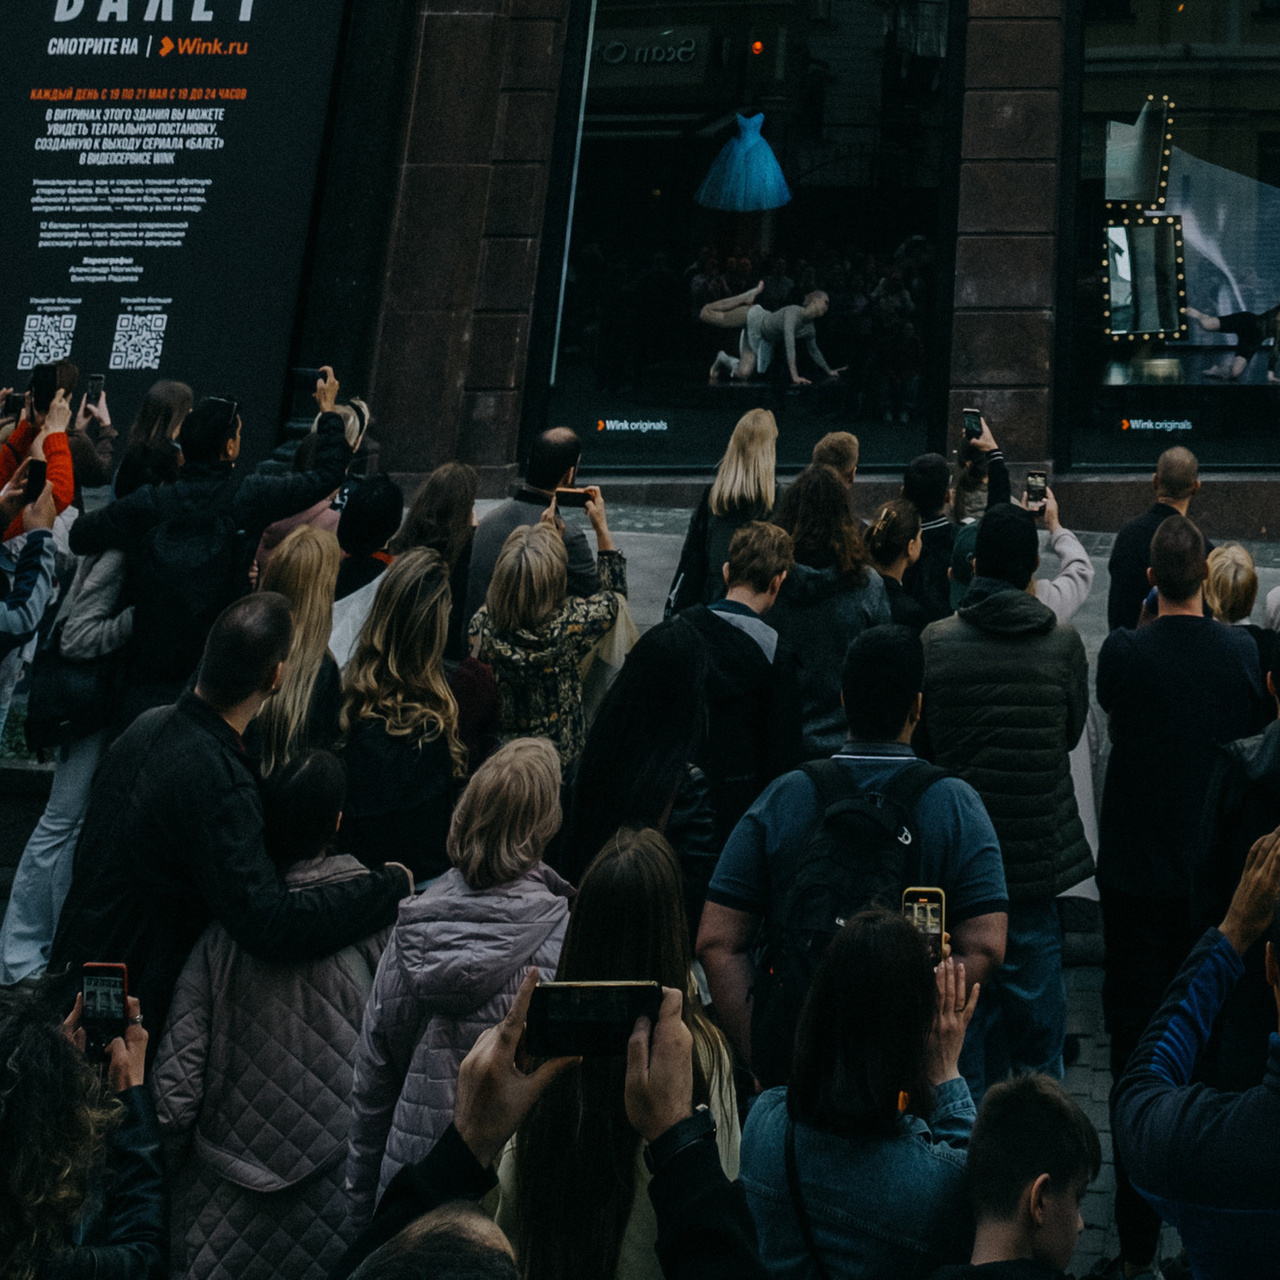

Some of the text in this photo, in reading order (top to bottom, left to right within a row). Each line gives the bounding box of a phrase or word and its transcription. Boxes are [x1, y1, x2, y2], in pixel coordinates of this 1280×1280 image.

[47, 37, 249, 55] СМОТРИТЕ НА Wink.ru
[30, 86, 247, 101] КАЖДЫЙ ДЕНЬ С 19 ПО 21 МАЯ С 19 ДО 24 ЧАСОВ
[45, 108, 225, 121] В ВИТРИНАХ ЭТОГО ЗДАНИЯ ВЫ МОЖЕТЕ
[47, 123, 89, 136] УВИДЕТЬ
[91, 123, 157, 136] ТЕАТРАЛЬНУЮ
[35, 138, 92, 151] СОЗДАННУЮ
[93, 138, 101, 151] К
[102, 138, 142, 151] ВЫХОДУ
[142, 138, 183, 151] СЕРИАЛА
[606, 420, 668, 433] Wink originals
[1129, 420, 1192, 432] Wink originals
